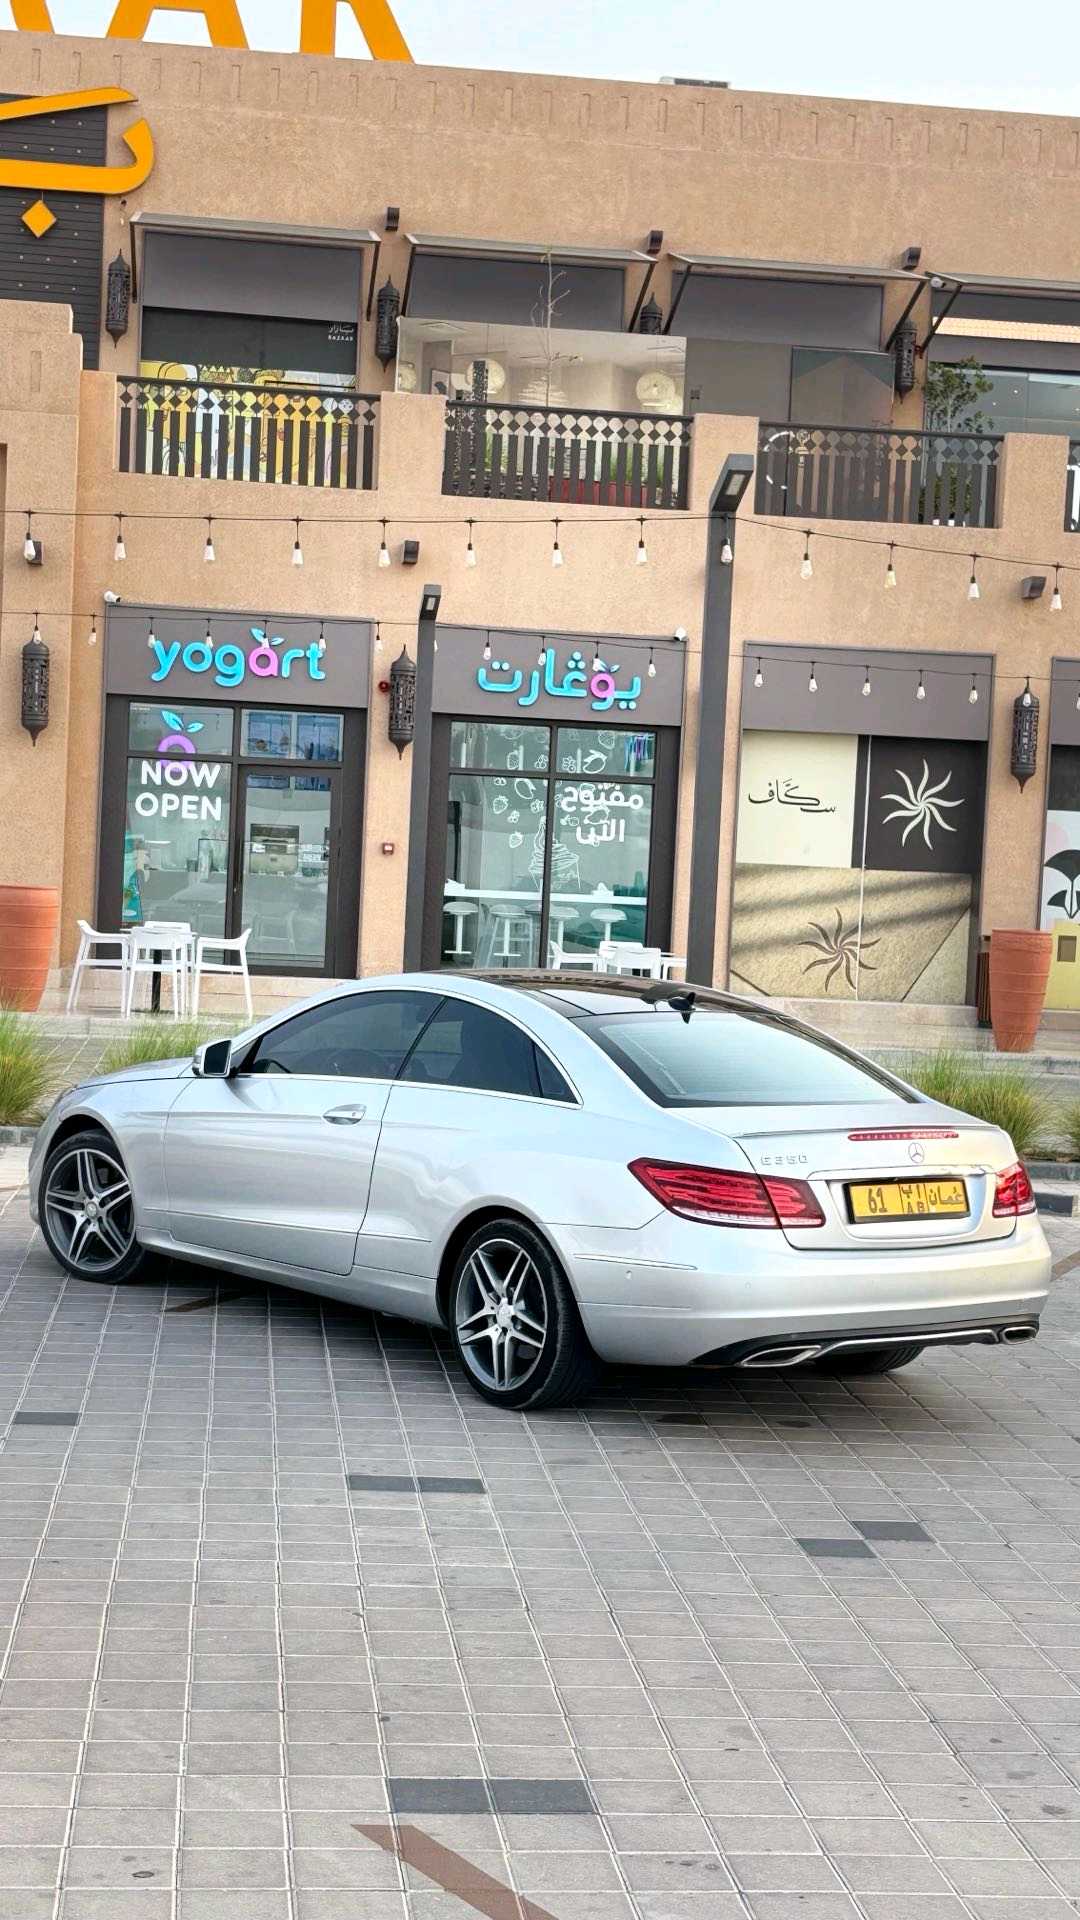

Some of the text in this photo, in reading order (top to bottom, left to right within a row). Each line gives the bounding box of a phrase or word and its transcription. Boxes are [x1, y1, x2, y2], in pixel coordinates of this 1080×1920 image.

[151, 639, 326, 687] yogart
[141, 760, 221, 788] NOW
[135, 792, 222, 821] OPEN
[868, 1187, 888, 1213] 61
